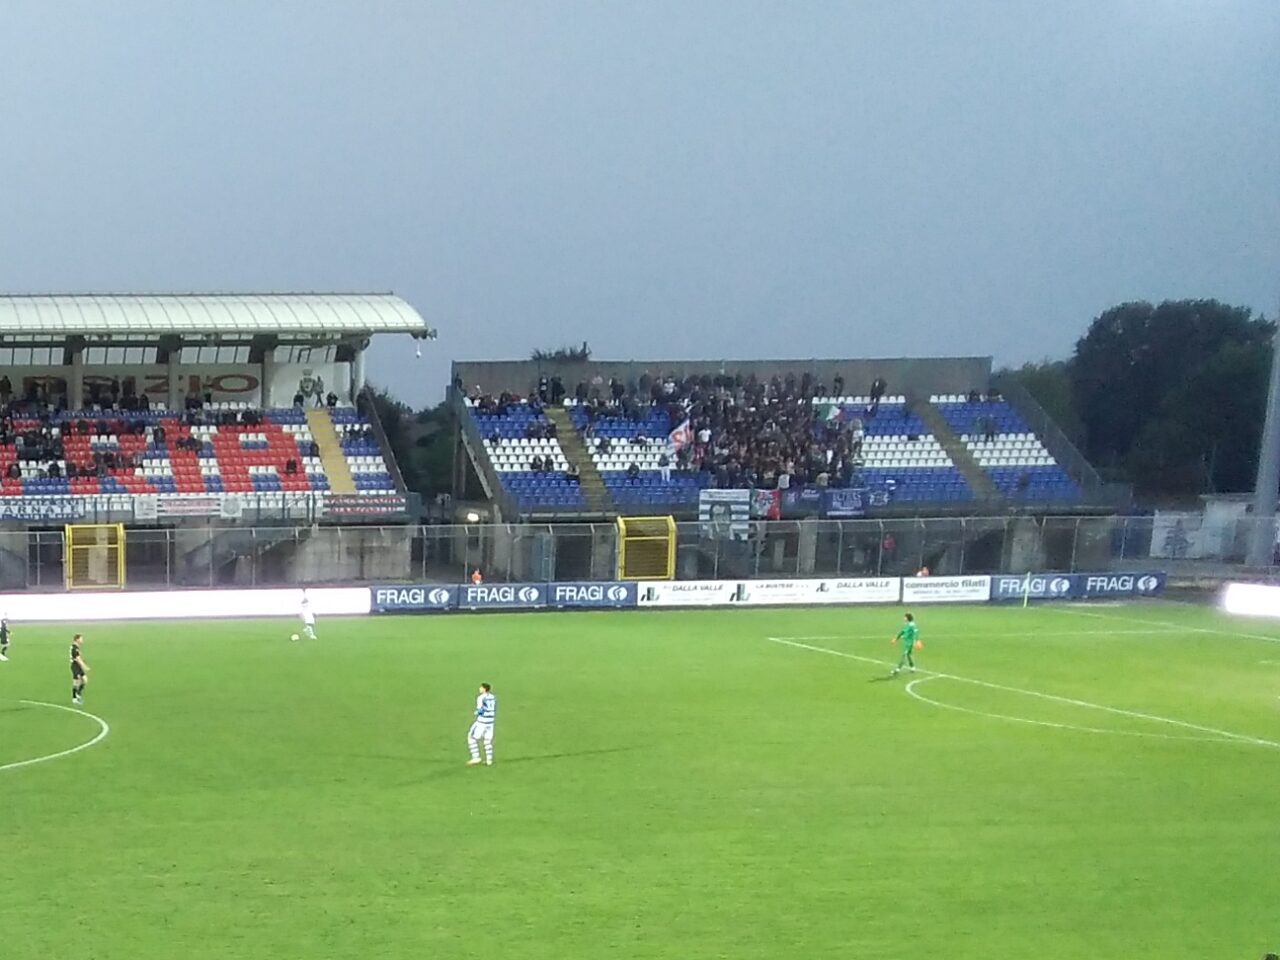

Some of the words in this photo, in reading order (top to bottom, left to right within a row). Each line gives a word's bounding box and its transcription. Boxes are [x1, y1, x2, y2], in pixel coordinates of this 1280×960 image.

[672, 584, 698, 592] DALLA
[700, 583, 724, 591] VALLE
[999, 577, 1046, 593] FRAGI
[1087, 576, 1134, 591] FRAGI
[377, 588, 424, 605] FRAGI
[467, 587, 514, 603] FRAGI
[556, 586, 604, 601] FRAGI
